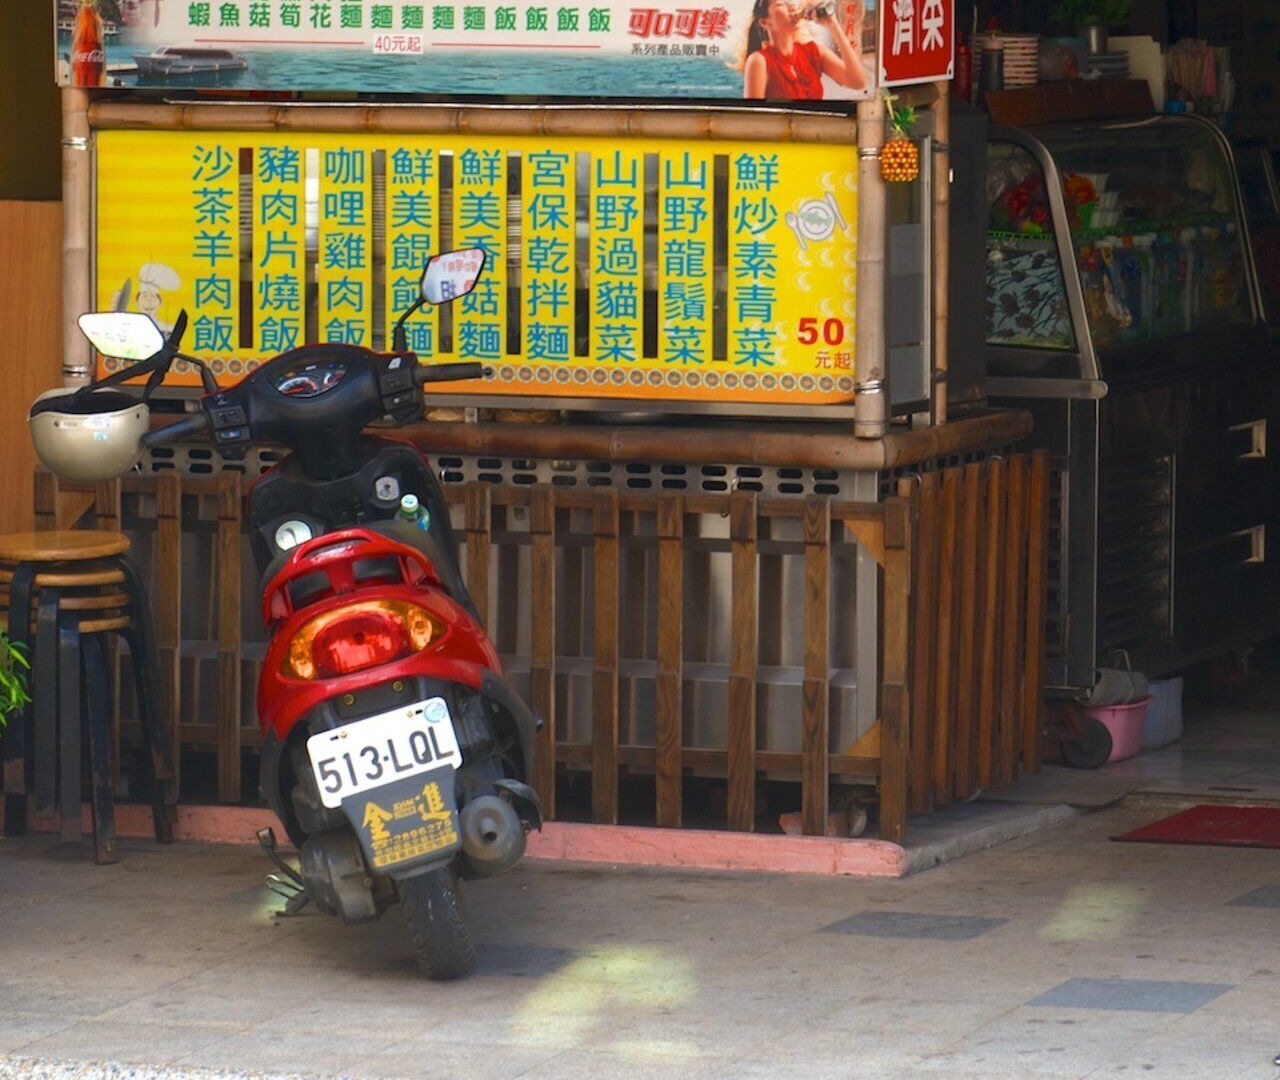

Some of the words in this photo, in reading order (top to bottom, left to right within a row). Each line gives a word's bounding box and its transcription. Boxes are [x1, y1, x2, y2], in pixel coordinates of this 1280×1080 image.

[374, 35, 422, 53] 40元起
[627, 7, 733, 40] 可口可樂
[630, 43, 720, 57] 系列產品販賣中
[192, 144, 234, 353] 沙茶羊肉飯
[258, 145, 301, 353] 豬肉片燒飯
[324, 146, 367, 347] 咖哩雞肉飯
[458, 148, 502, 360] 鮮美香菇麵
[527, 149, 570, 361] 宮保乾拌麵
[595, 149, 638, 363] 山野過貓菜
[664, 151, 708, 365] 山野龍鬚菜
[732, 152, 780, 367] 鮮炒素青菜
[797, 317, 845, 347] 50
[814, 350, 852, 371] 元起
[317, 724, 455, 796] 513-LQL
